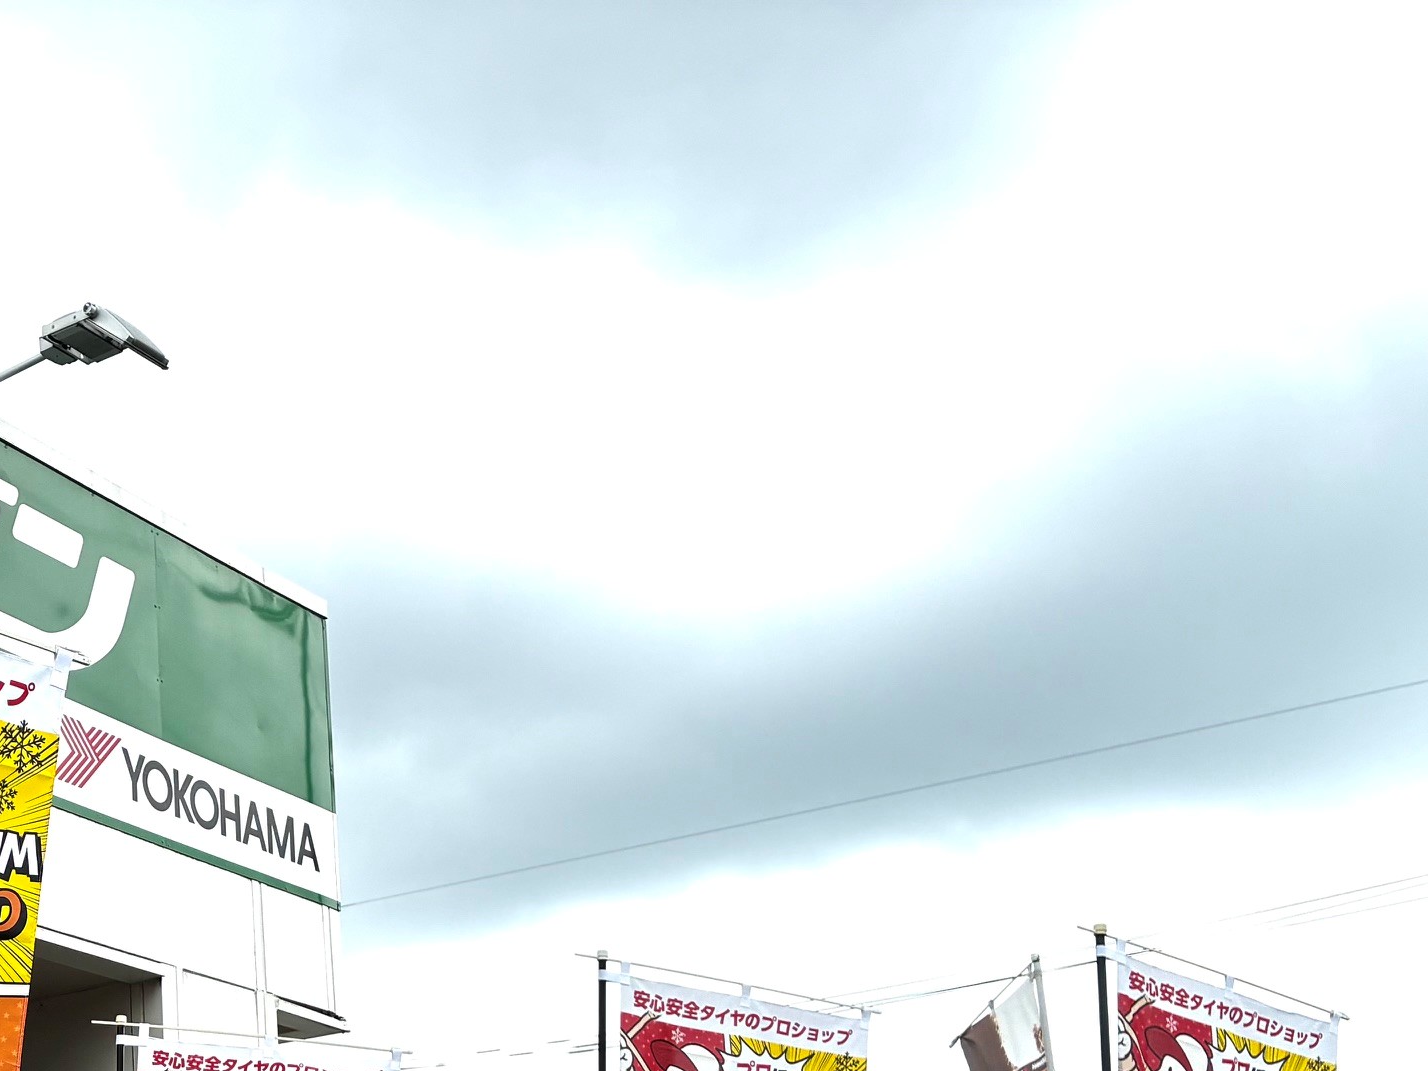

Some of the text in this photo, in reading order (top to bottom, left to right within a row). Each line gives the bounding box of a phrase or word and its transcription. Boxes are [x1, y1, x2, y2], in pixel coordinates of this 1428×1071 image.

[124, 748, 320, 873] YOKOHAMA
[633, 990, 853, 1046] 安心安全タイヤのプロショップ
[1129, 971, 1322, 1048] 安心安全タイヤのプロショップ
